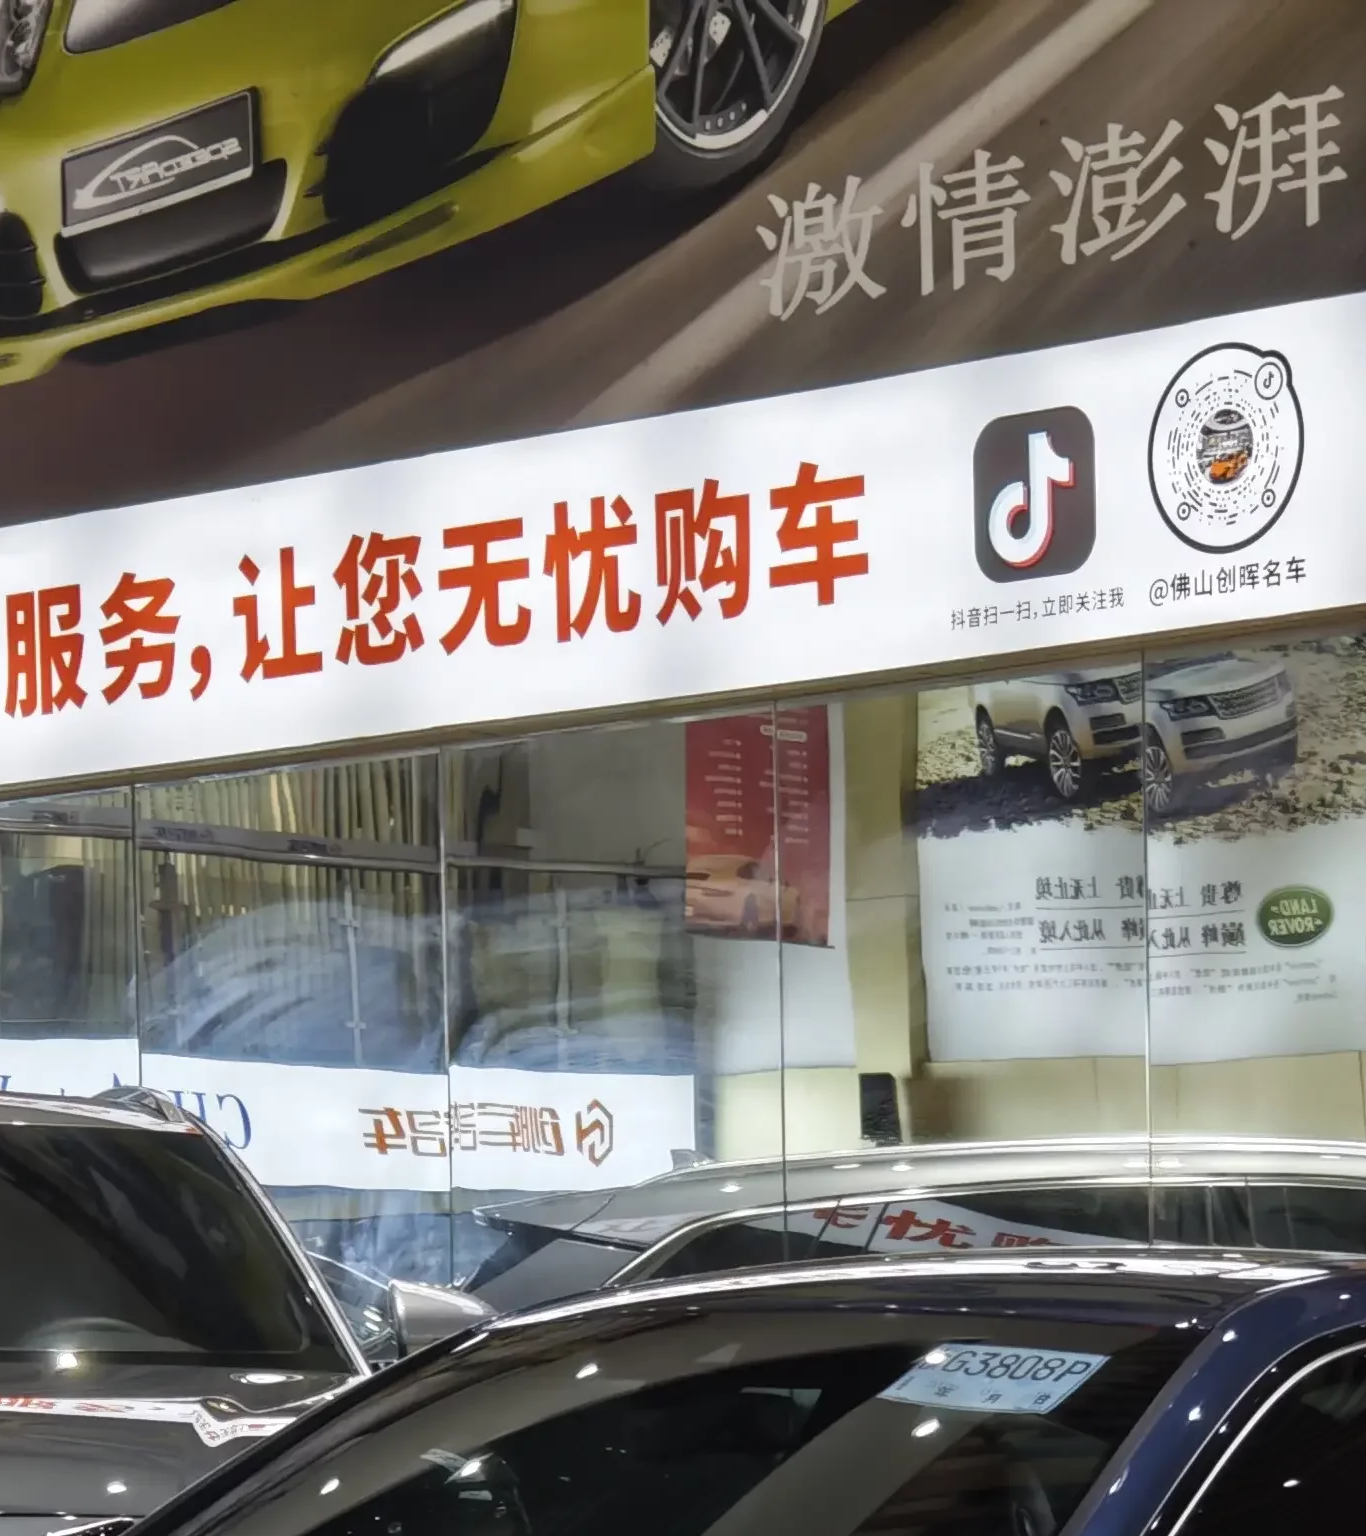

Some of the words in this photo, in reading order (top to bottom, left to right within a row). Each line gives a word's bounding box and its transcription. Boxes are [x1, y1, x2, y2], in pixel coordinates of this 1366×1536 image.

[755, 85, 1349, 322] 激情澎湃
[1149, 556, 1306, 607] @佛山创晖名车
